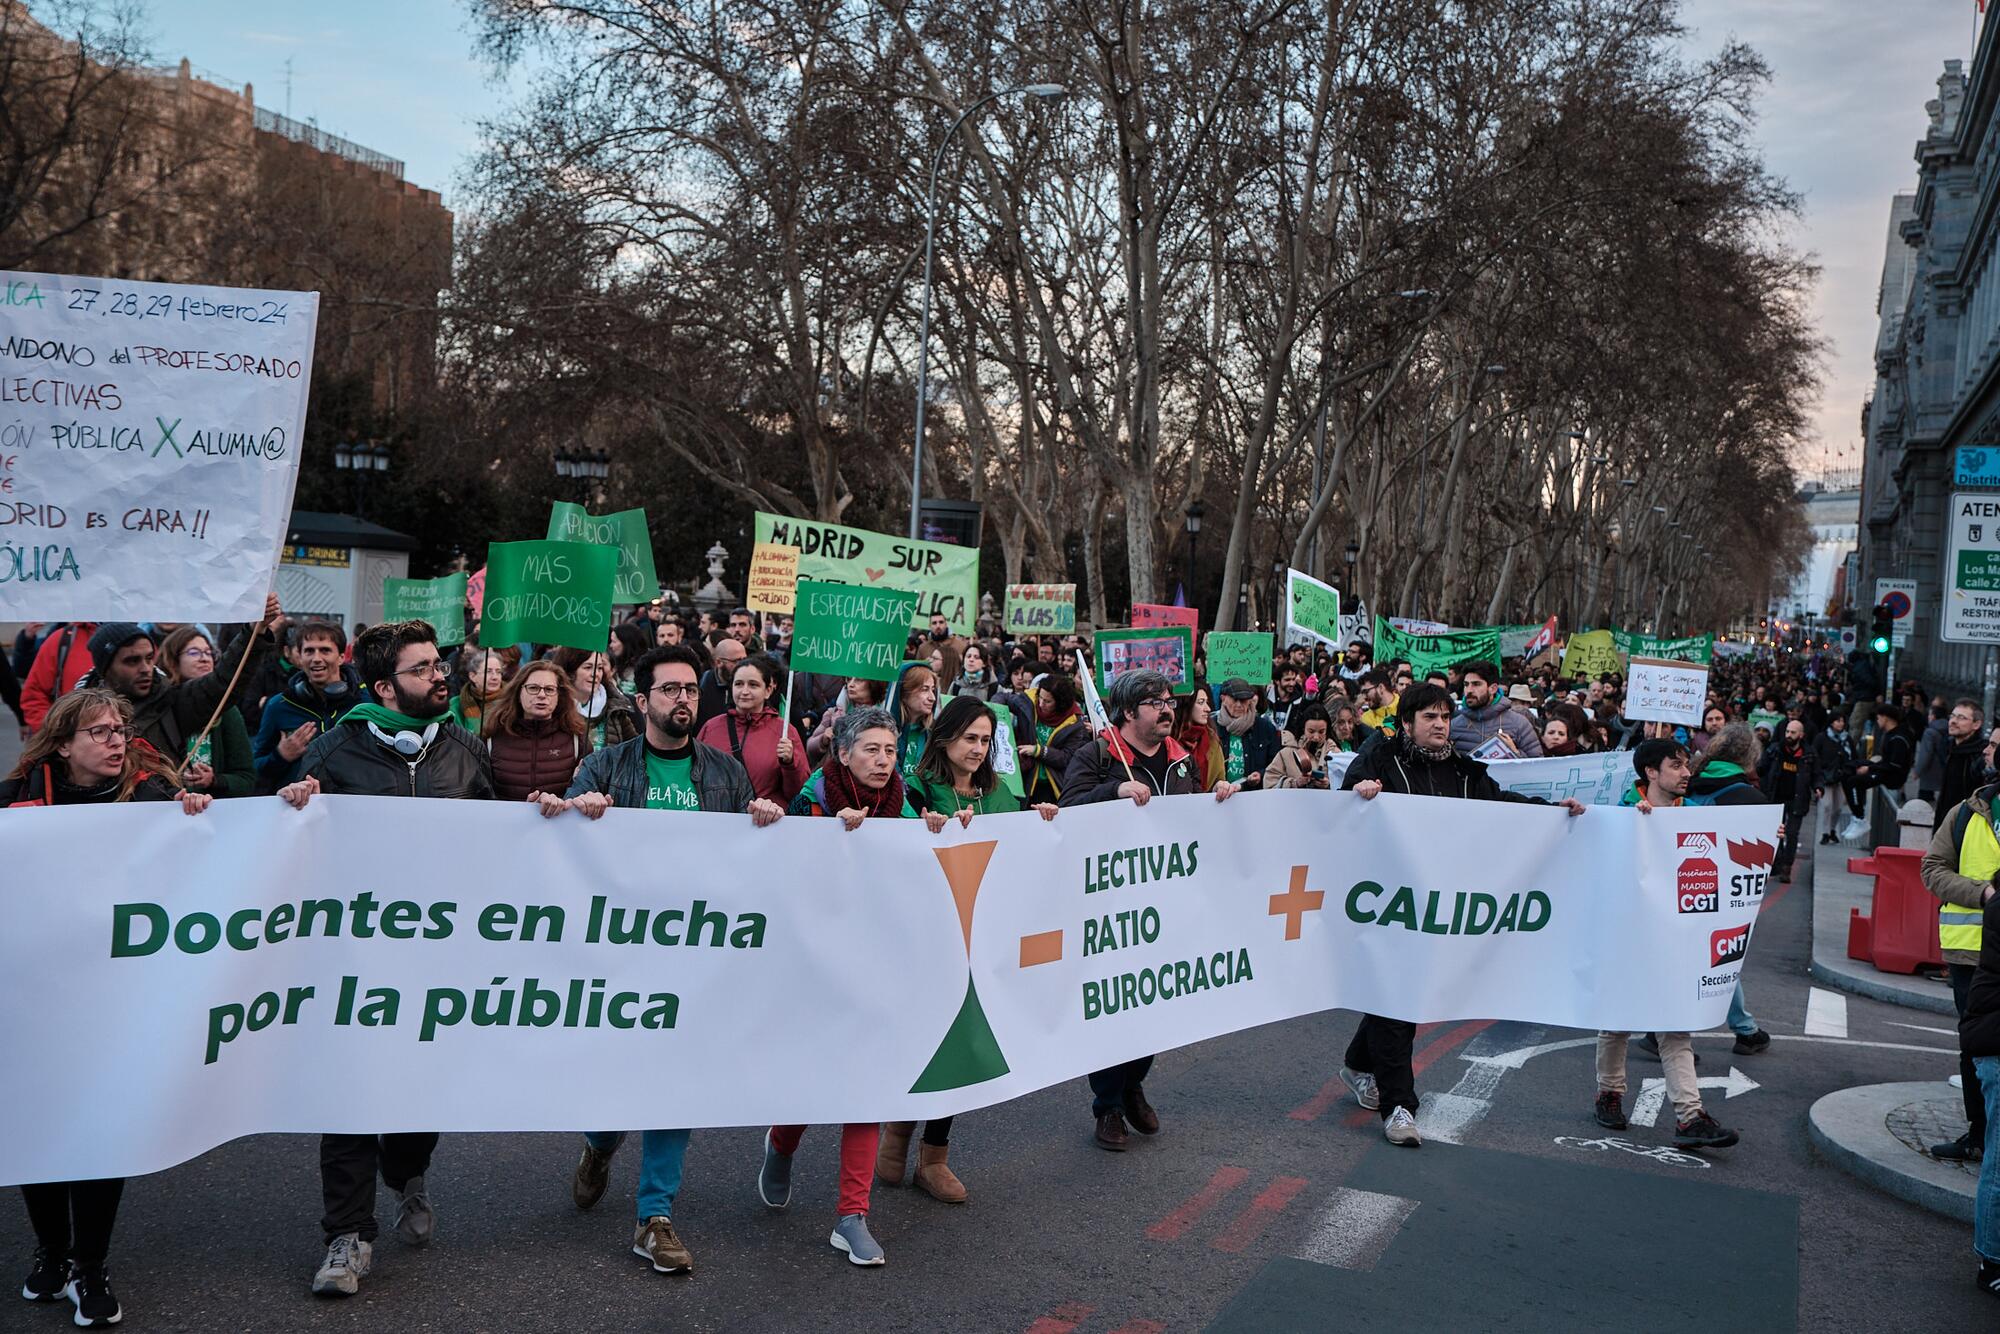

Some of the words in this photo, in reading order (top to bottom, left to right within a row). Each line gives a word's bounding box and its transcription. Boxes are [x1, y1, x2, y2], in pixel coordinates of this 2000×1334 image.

[0, 280, 46, 309] ICA
[109, 347, 131, 364] del
[133, 346, 301, 379] PROFESORADO
[2, 377, 122, 411] LECTIVAS
[51, 420, 144, 452] PÚBLICA
[151, 416, 184, 458] X
[186, 426, 285, 461] ALUMN@
[770, 520, 865, 561] MADRID
[887, 545, 943, 577] SUR
[1964, 564, 1985, 575] Los
[1964, 577, 1991, 588] calle
[842, 622, 859, 640] EN
[1011, 607, 1024, 626] A
[1027, 606, 1054, 628] LAS
[796, 636, 843, 663] SALUD
[846, 641, 900, 670] MENTAL
[1615, 631, 1632, 646] IES
[676, 787, 699, 808] PÚB
[1084, 840, 1200, 894] LECTIVAS
[1680, 881, 1715, 891] MADRID
[1680, 893, 1717, 912] CGT
[110, 891, 459, 958] Docentes
[475, 902, 566, 943] en
[583, 894, 768, 950] lucha
[1082, 905, 1161, 957] RATIO
[1344, 880, 1553, 936] CALIDAD
[1716, 934, 1746, 957] CNT
[1082, 947, 1254, 1021] BUROCRACIA
[1701, 974, 1731, 987] Sección
[203, 984, 316, 1065] por
[333, 976, 401, 1028] la
[418, 976, 681, 1042] pública
